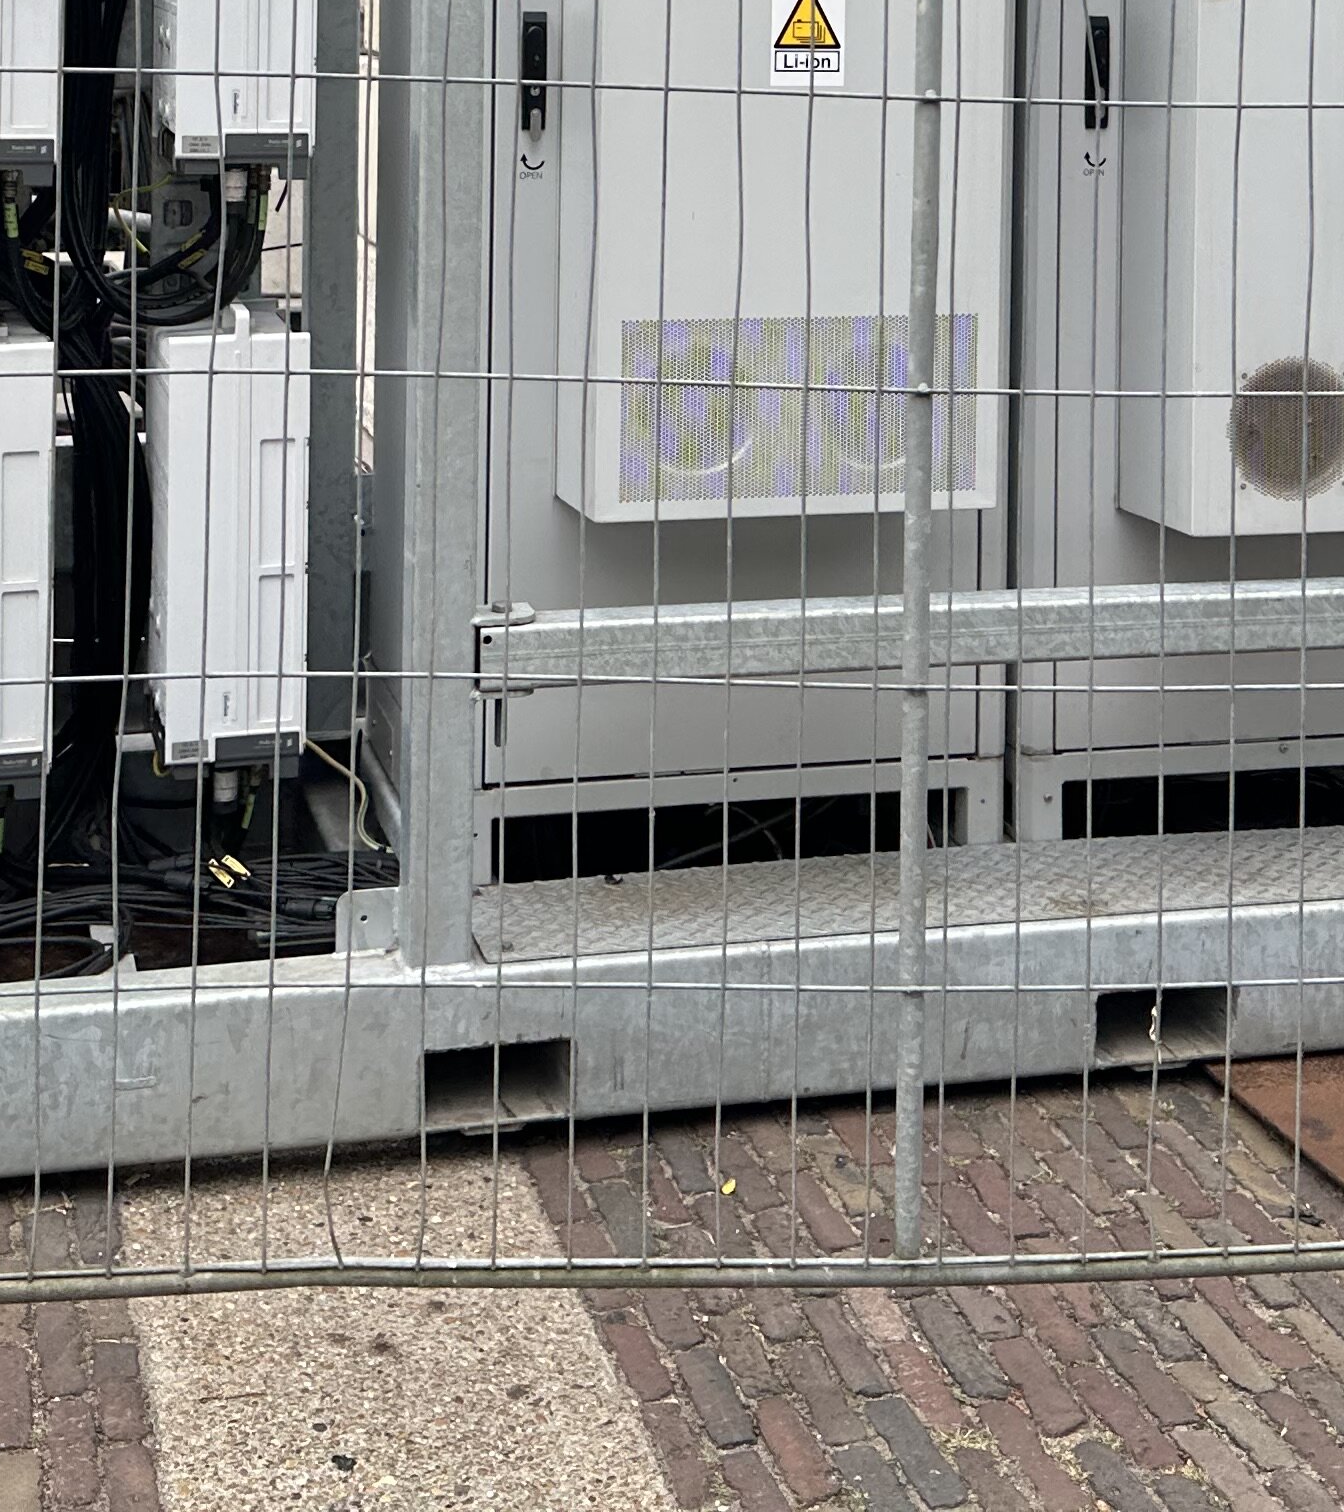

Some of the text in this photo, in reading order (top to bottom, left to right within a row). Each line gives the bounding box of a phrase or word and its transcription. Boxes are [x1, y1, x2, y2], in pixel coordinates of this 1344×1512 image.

[783, 53, 831, 69] Li-ion
[519, 171, 543, 180] OPEN
[1083, 168, 1104, 177] OPN
